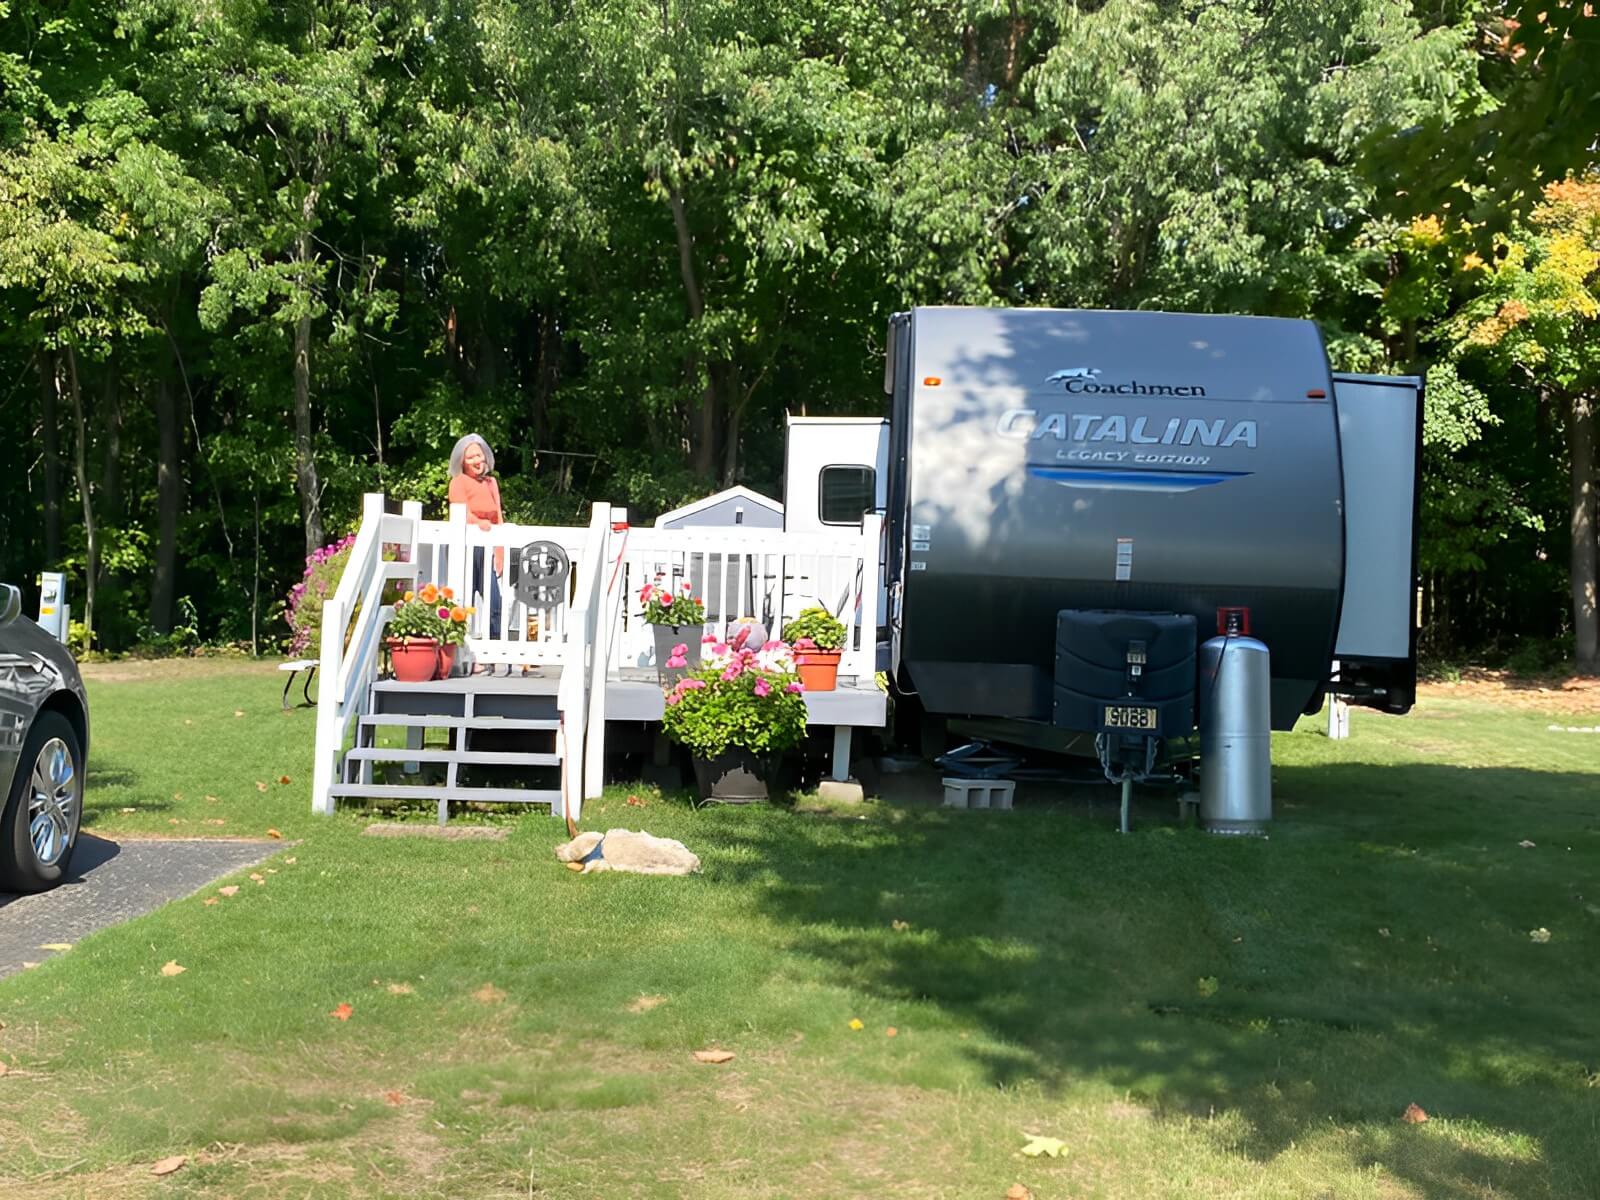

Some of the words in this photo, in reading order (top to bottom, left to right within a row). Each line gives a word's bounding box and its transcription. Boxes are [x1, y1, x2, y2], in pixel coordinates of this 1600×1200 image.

[1065, 379, 1206, 397] Coachmen
[996, 408, 1257, 448] CATALINA
[1056, 449, 1129, 462] LEGACY
[1134, 453, 1211, 466] EDITION
